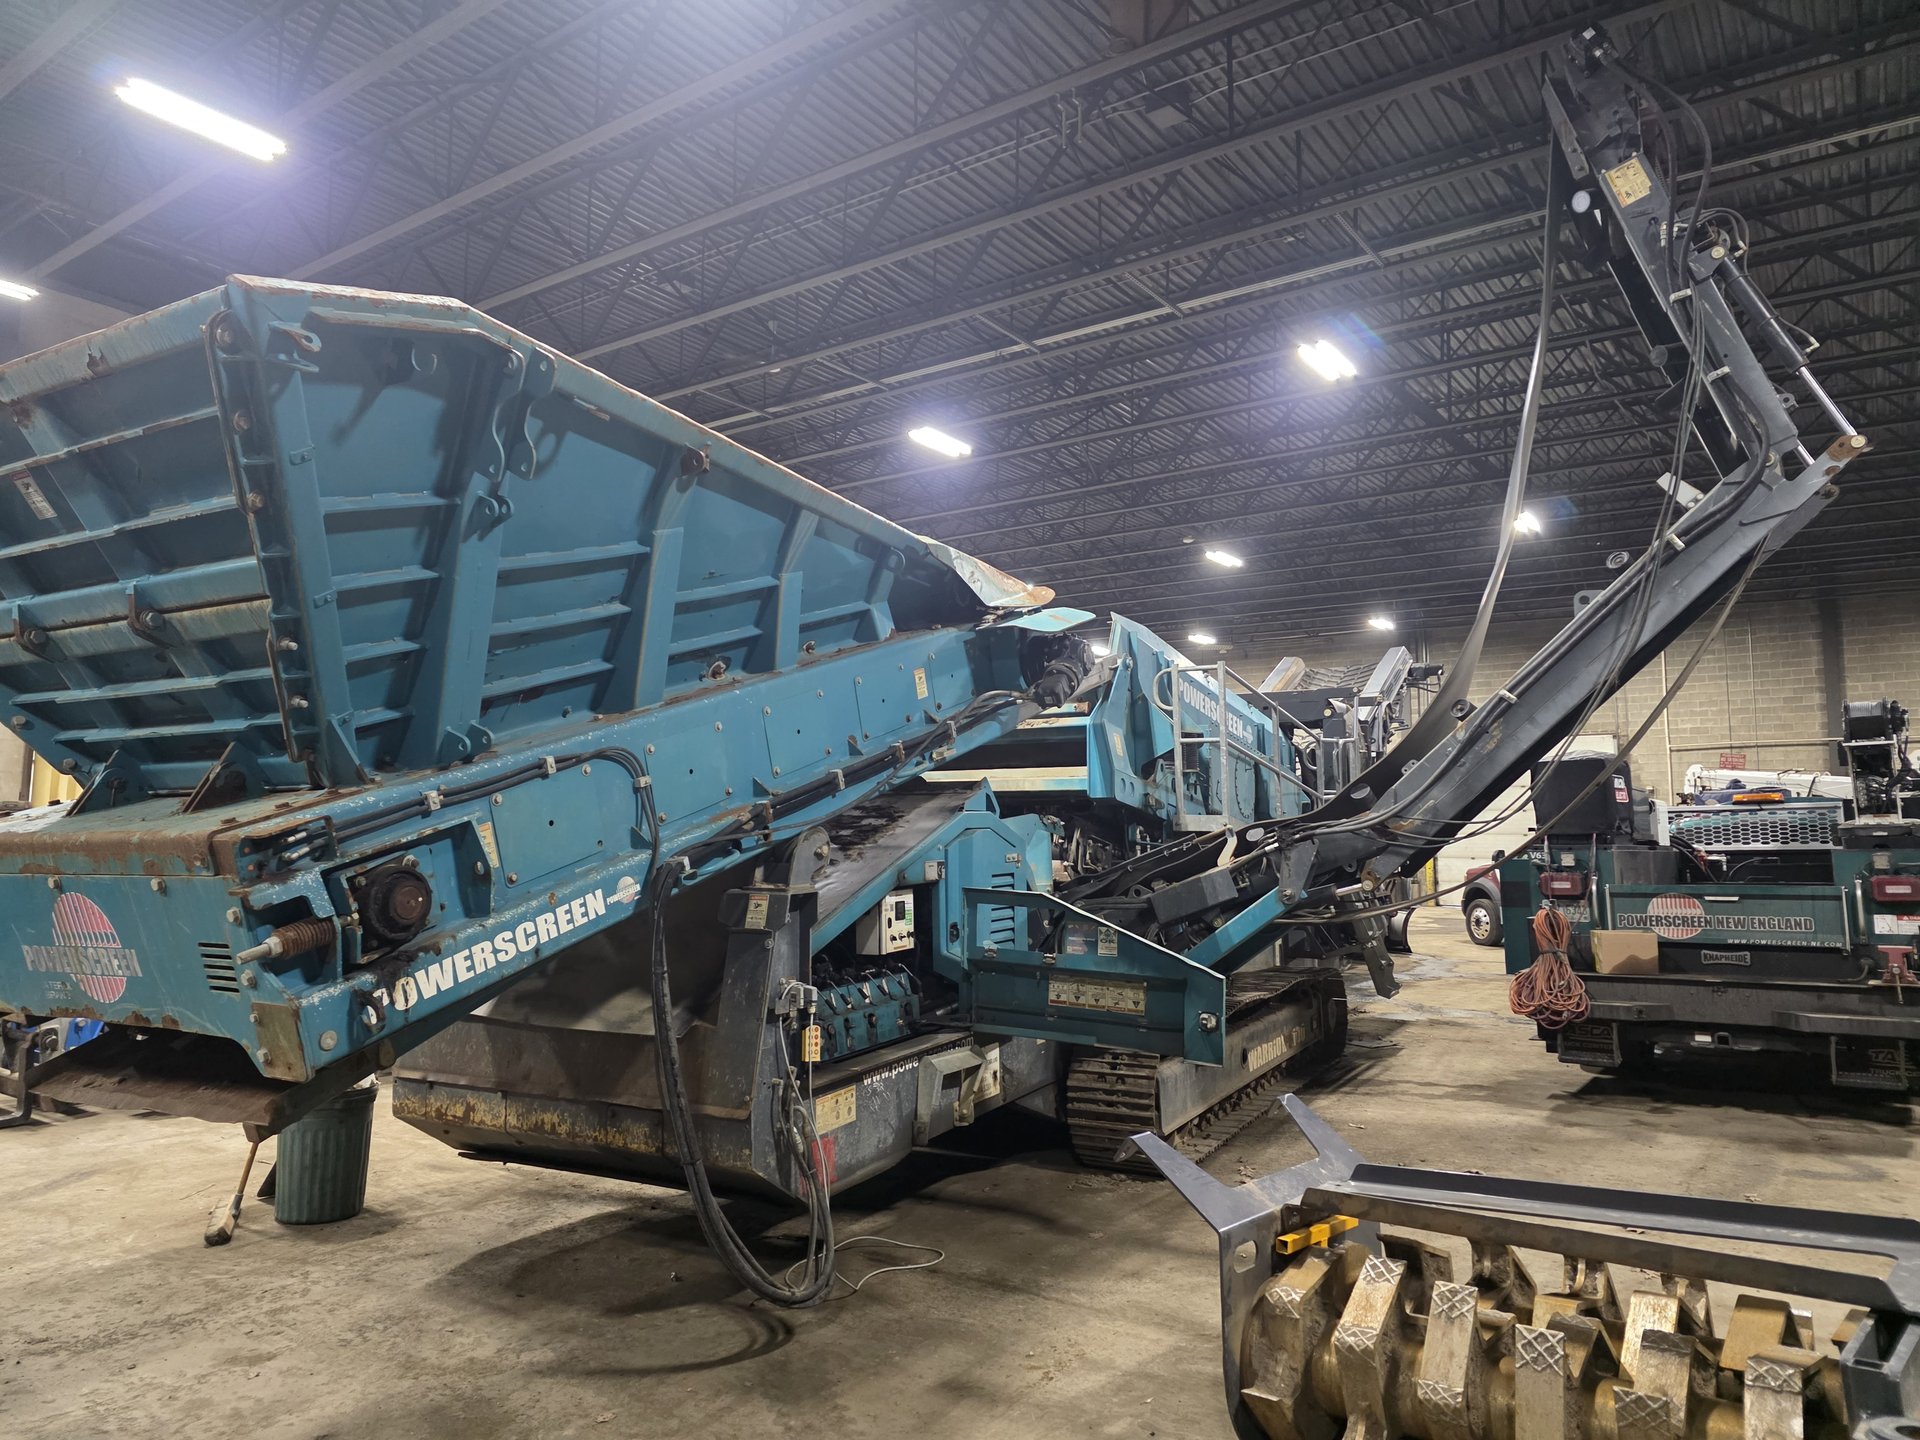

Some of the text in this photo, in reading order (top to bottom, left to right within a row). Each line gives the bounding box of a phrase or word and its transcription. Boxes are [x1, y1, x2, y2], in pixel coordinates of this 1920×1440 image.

[1617, 913, 1815, 932] POWERSCREEN NEW ENGLAND
[1727, 937, 1843, 948] WWW.POWERSCREEN-NE.COM
[21, 944, 143, 978] POWERSCREEN
[1702, 951, 1750, 965] KNAPHEIDE
